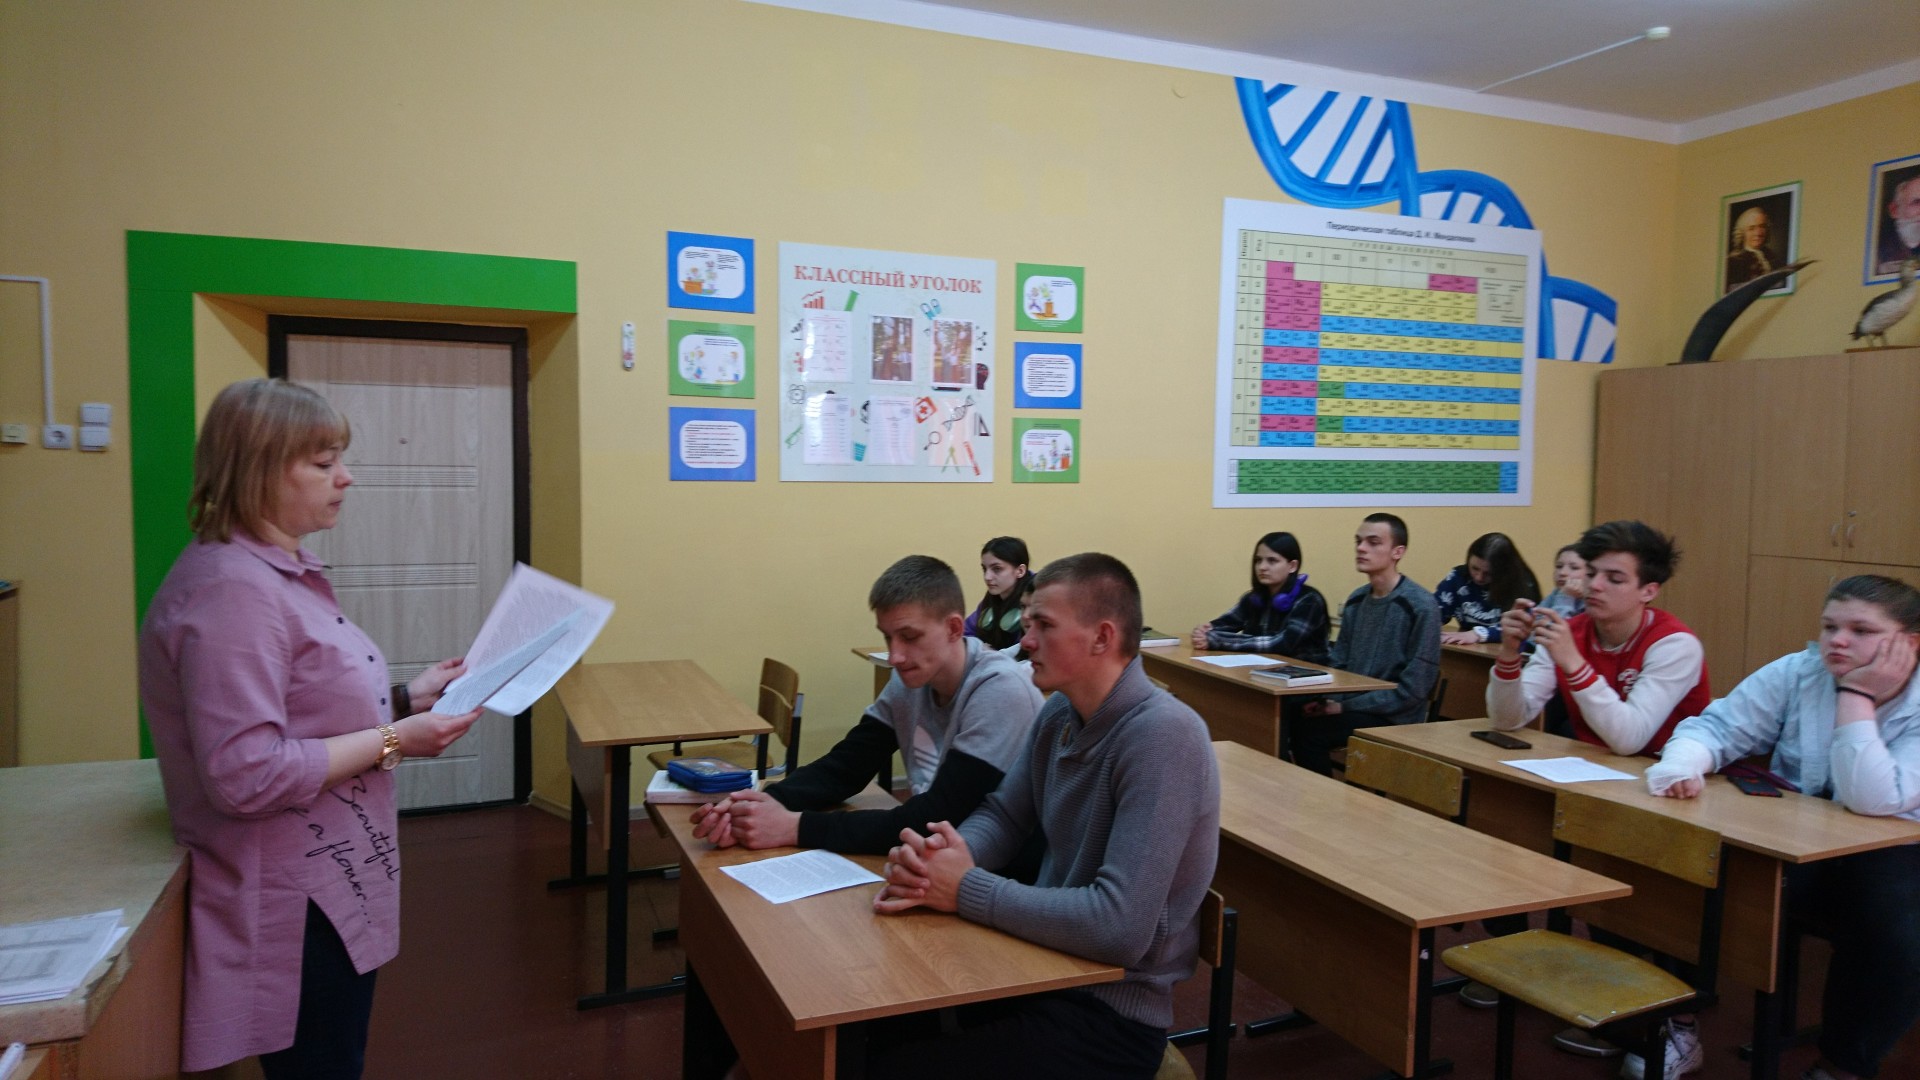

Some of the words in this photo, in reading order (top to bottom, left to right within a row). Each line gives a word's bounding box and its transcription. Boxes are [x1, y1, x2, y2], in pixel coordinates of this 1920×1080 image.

[794, 264, 905, 288] КЛАССНЫЙ
[909, 274, 982, 294] УГОЛОК
[308, 823, 325, 841] a
[328, 774, 400, 881] Beautiful
